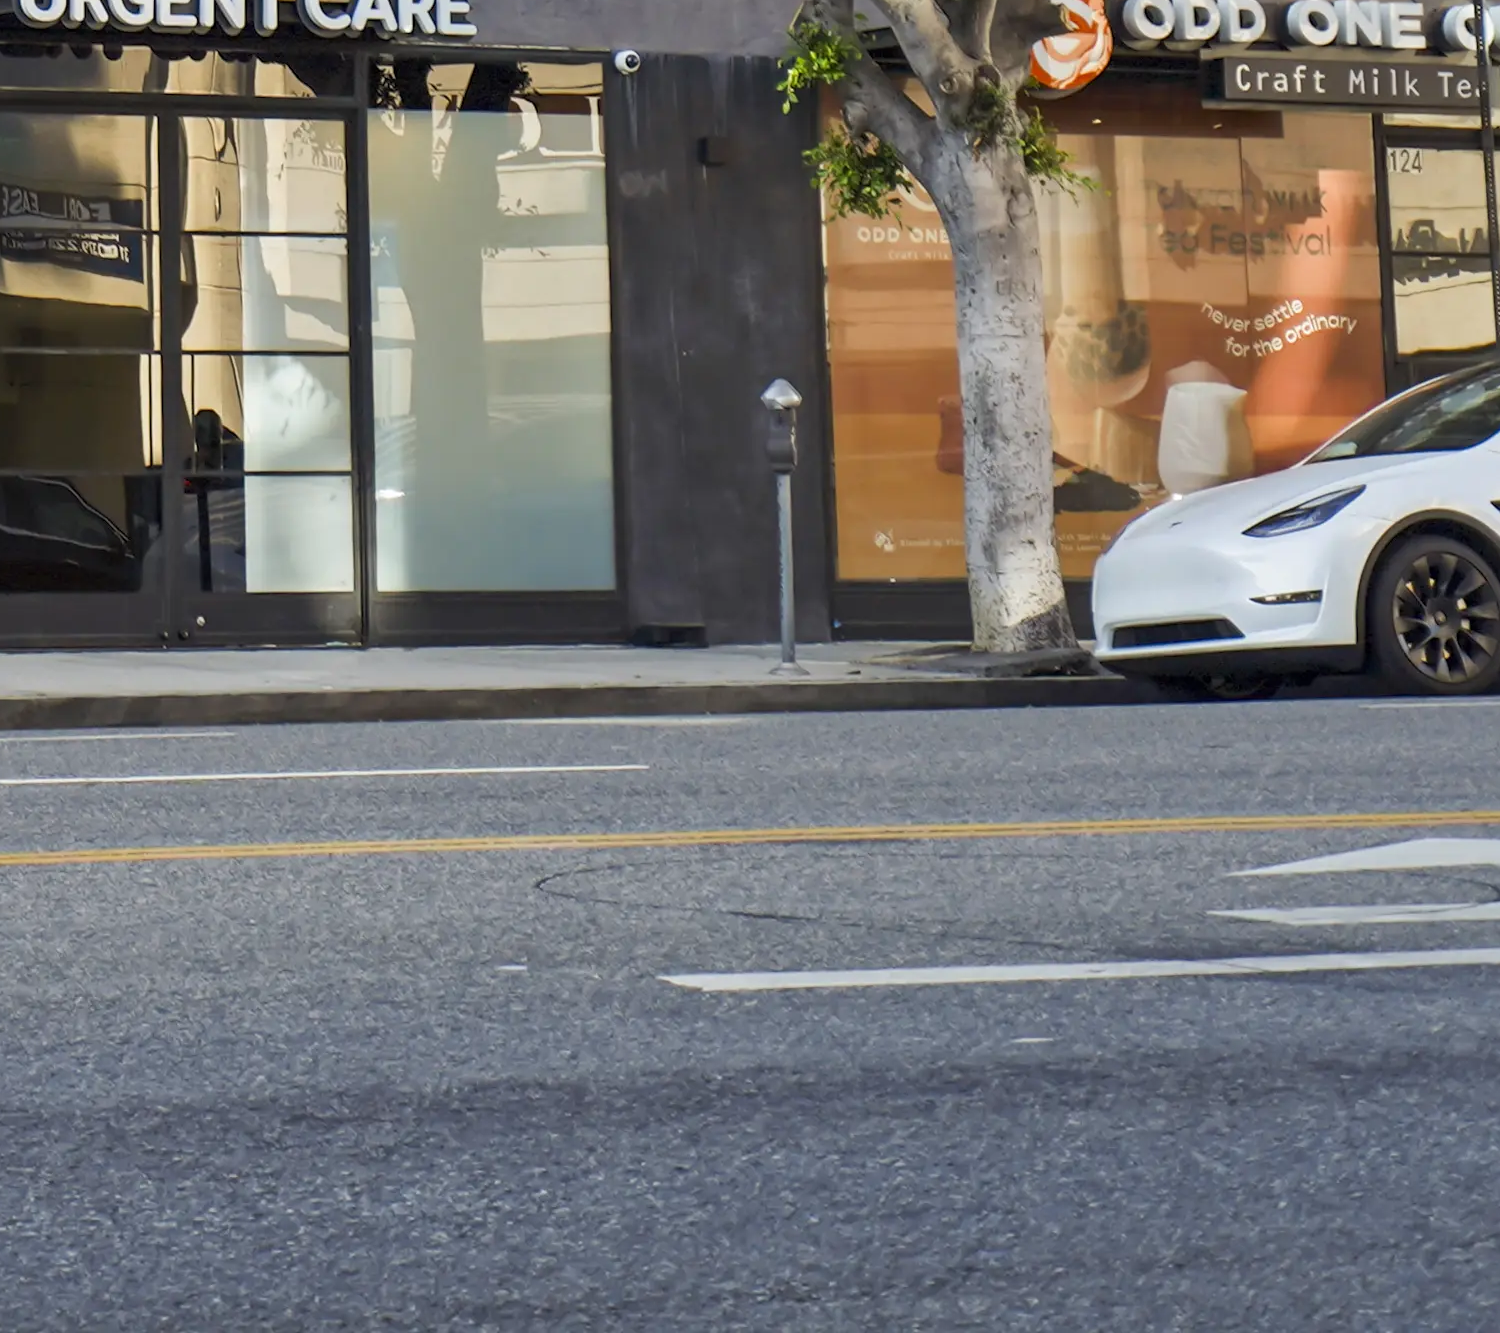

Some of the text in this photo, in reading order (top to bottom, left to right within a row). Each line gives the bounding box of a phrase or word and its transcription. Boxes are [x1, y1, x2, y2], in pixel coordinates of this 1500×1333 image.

[1235, 63, 1481, 99] Craft Milk Te
[1389, 148, 1423, 174] 124
[857, 226, 900, 244] ODD
[1209, 223, 1332, 256] Festival
[1200, 298, 1304, 333] never settle
[1224, 313, 1358, 357] for the ordinary
